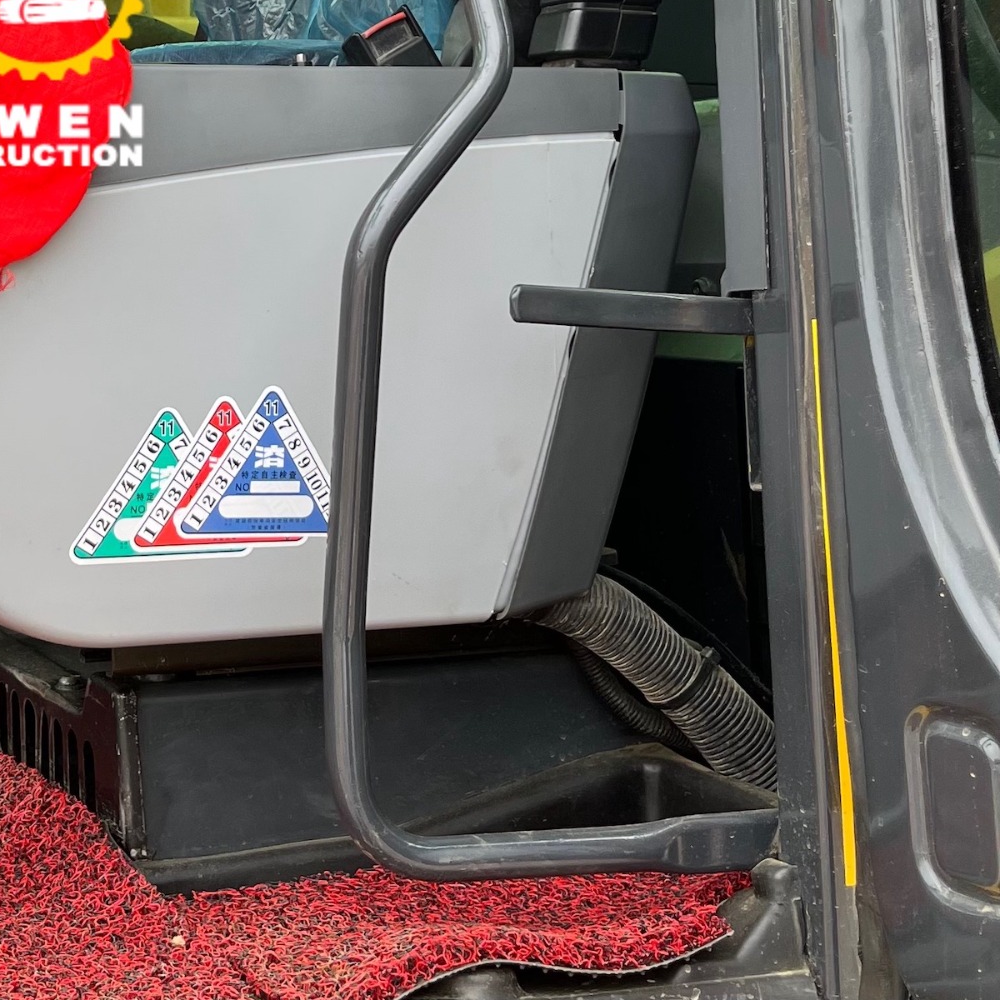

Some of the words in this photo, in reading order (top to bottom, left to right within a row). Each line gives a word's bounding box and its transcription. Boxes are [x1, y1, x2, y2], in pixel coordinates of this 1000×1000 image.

[217, 409, 232, 426] 11
[263, 399, 279, 416] 11
[159, 419, 175, 436] 11
[174, 438, 188, 450] 7
[278, 418, 292, 430] 7
[288, 438, 301, 450] 8
[298, 456, 310, 469] 9
[306, 472, 322, 490] 10
[254, 444, 285, 468] 済
[190, 514, 204, 526] 1
[202, 495, 217, 508] 2
[215, 475, 228, 490] 3
[227, 457, 241, 470] 4
[239, 437, 252, 451] 5
[252, 419, 265, 433] 6
[143, 526, 157, 538] 1
[156, 507, 170, 520] 2
[168, 487, 182, 501] 3
[180, 469, 194, 482] 4
[192, 449, 205, 462] 5
[205, 429, 218, 443] 6
[235, 483, 249, 491] NO
[83, 538, 98, 550] 1
[96, 518, 110, 532] 2
[109, 498, 123, 513] 3
[121, 480, 136, 493] 4
[134, 459, 147, 473] 5
[146, 440, 160, 454] 6
